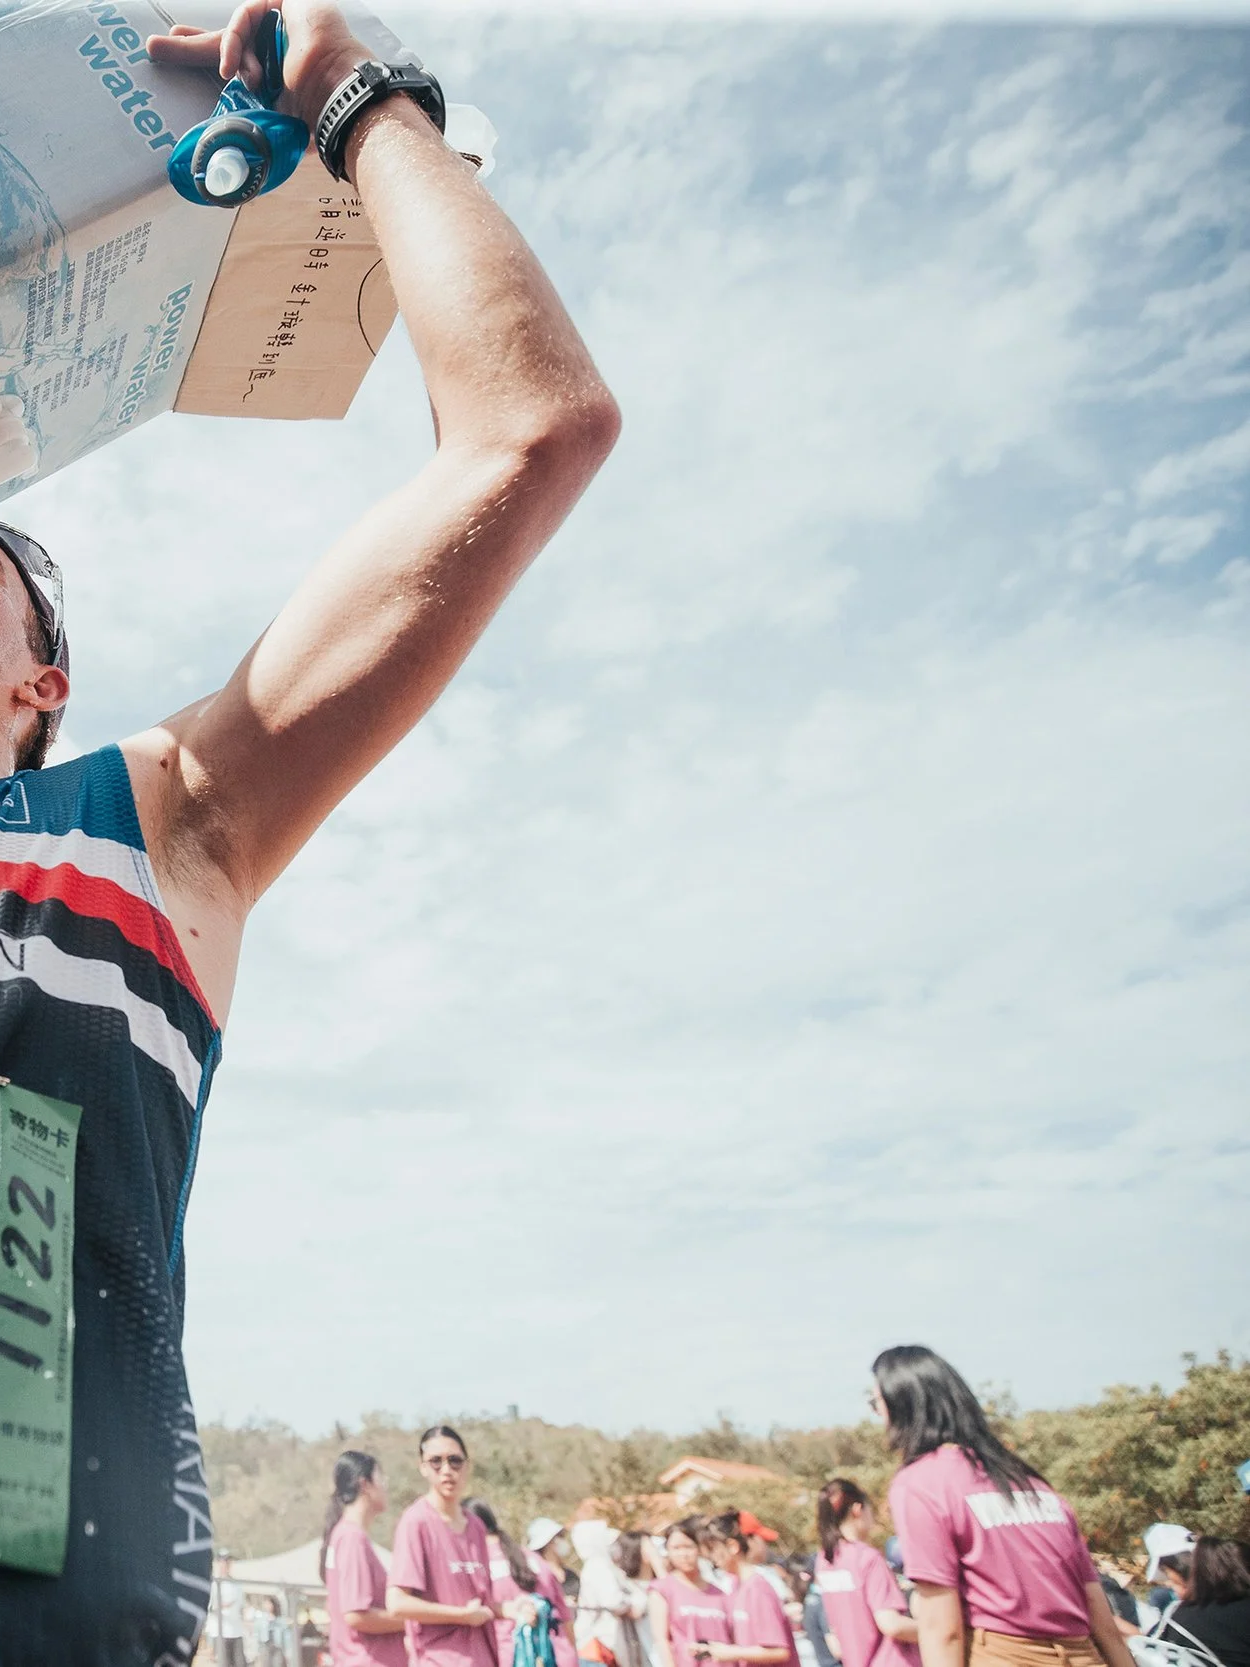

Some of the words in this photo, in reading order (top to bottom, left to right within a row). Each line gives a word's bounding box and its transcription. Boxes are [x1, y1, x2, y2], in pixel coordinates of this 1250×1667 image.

[78, 33, 178, 150] water
[152, 286, 196, 375] power
[116, 353, 151, 428] water
